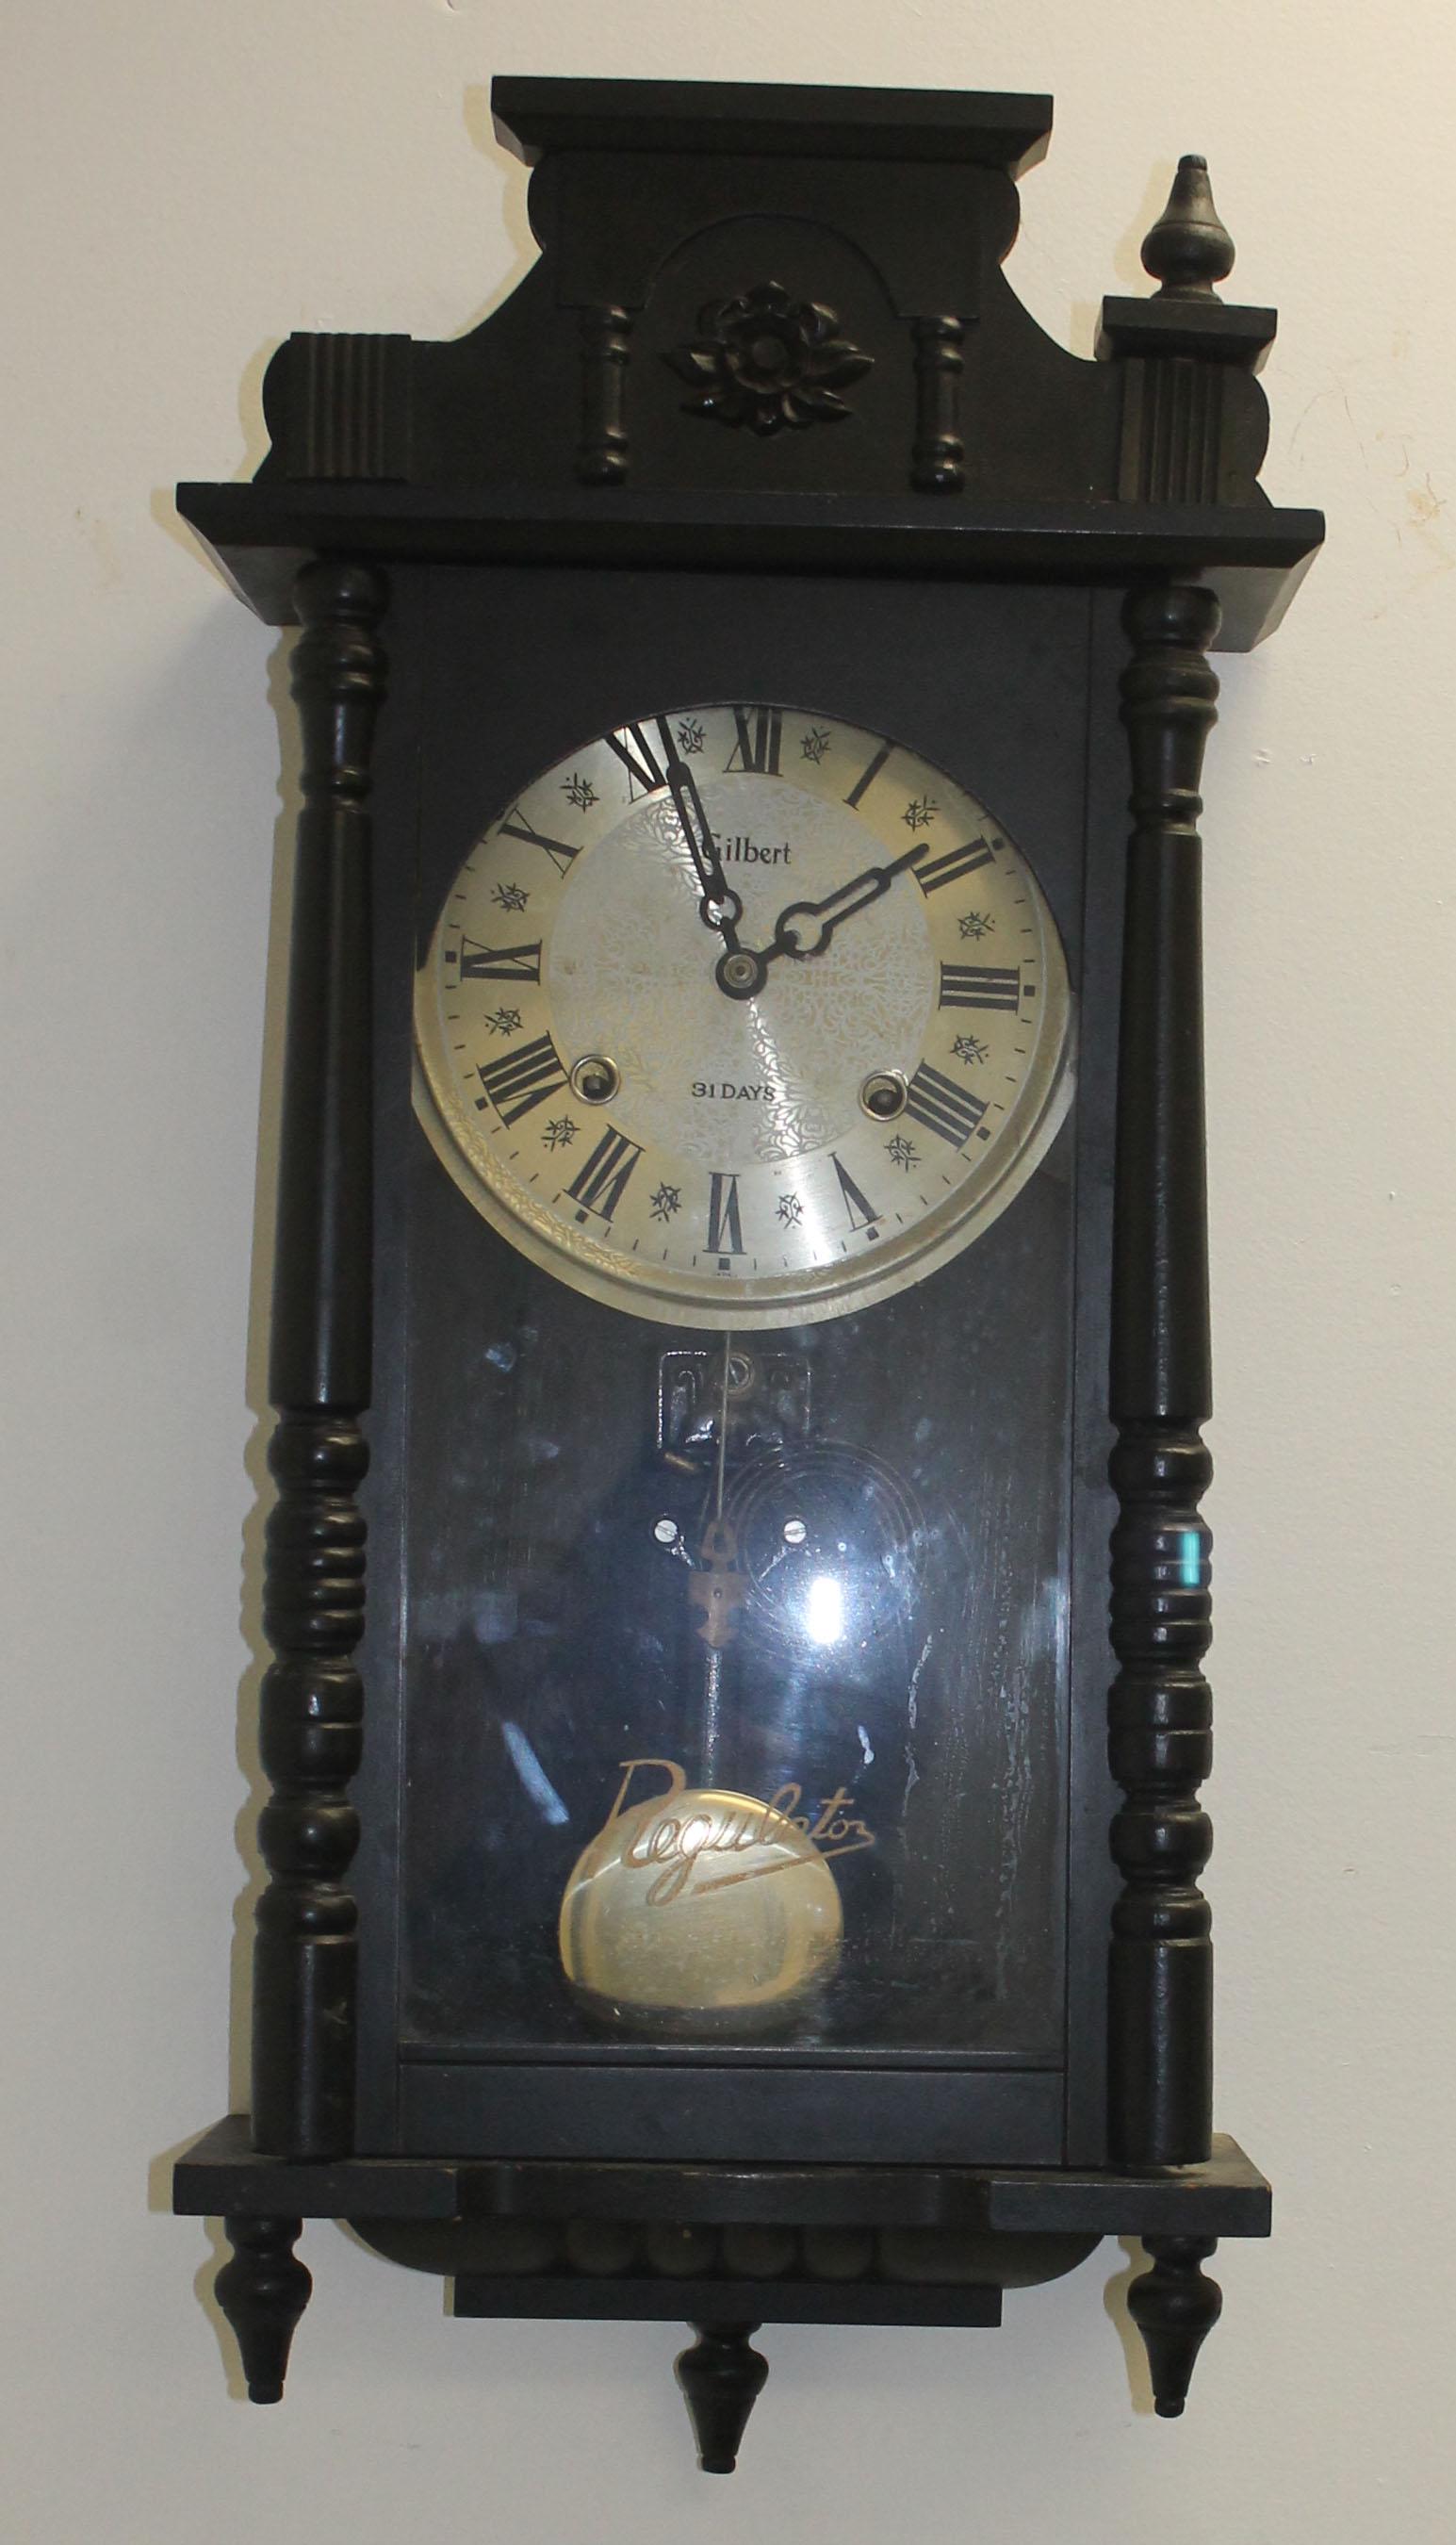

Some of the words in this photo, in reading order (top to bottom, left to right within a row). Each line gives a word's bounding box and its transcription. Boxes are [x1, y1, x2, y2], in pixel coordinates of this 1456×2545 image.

[723, 707, 783, 777] XII
[498, 806, 584, 879] X
[911, 835, 996, 898] II
[461, 934, 542, 986] IX
[939, 961, 1020, 1015] III
[476, 1029, 570, 1130] VIII
[691, 1082, 715, 1098] 31
[721, 1084, 777, 1102] DAYS
[563, 1123, 646, 1223] VII
[702, 1172, 747, 1256] VI
